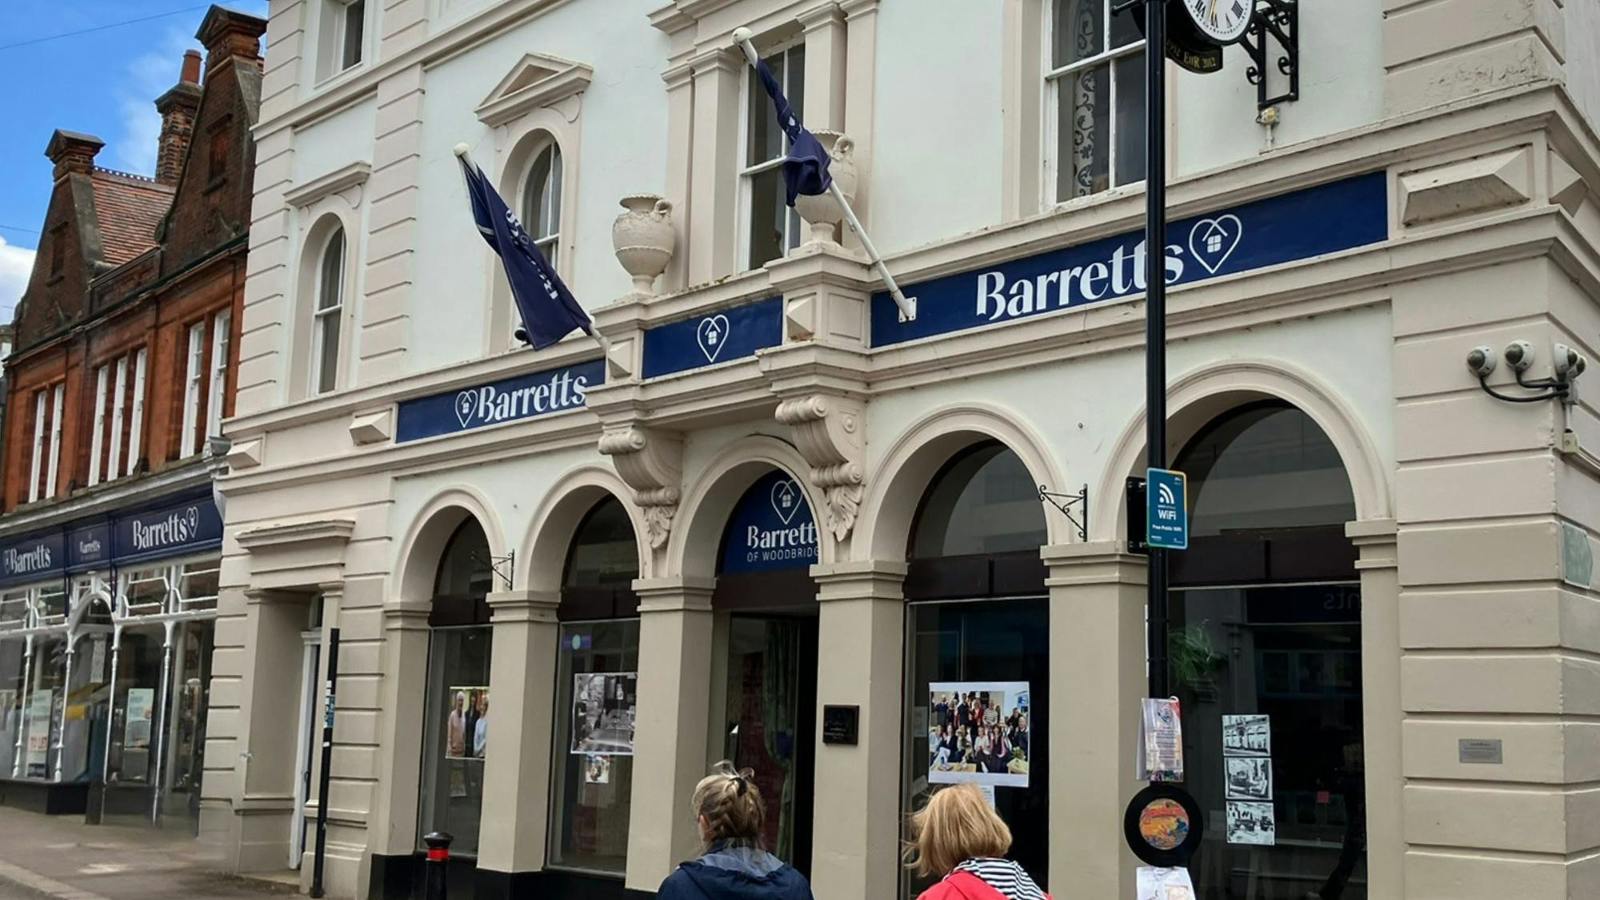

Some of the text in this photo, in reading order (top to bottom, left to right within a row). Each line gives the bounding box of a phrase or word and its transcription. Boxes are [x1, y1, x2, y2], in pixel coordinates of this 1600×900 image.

[976, 239, 1184, 321] Barretts
[478, 370, 588, 422] Barretts
[1157, 509, 1177, 520] WiFi
[133, 512, 188, 550] Barretts
[747, 521, 818, 549] Barrett
[10, 544, 52, 574] Barretts
[746, 547, 819, 563] OF WOODBRIDG
